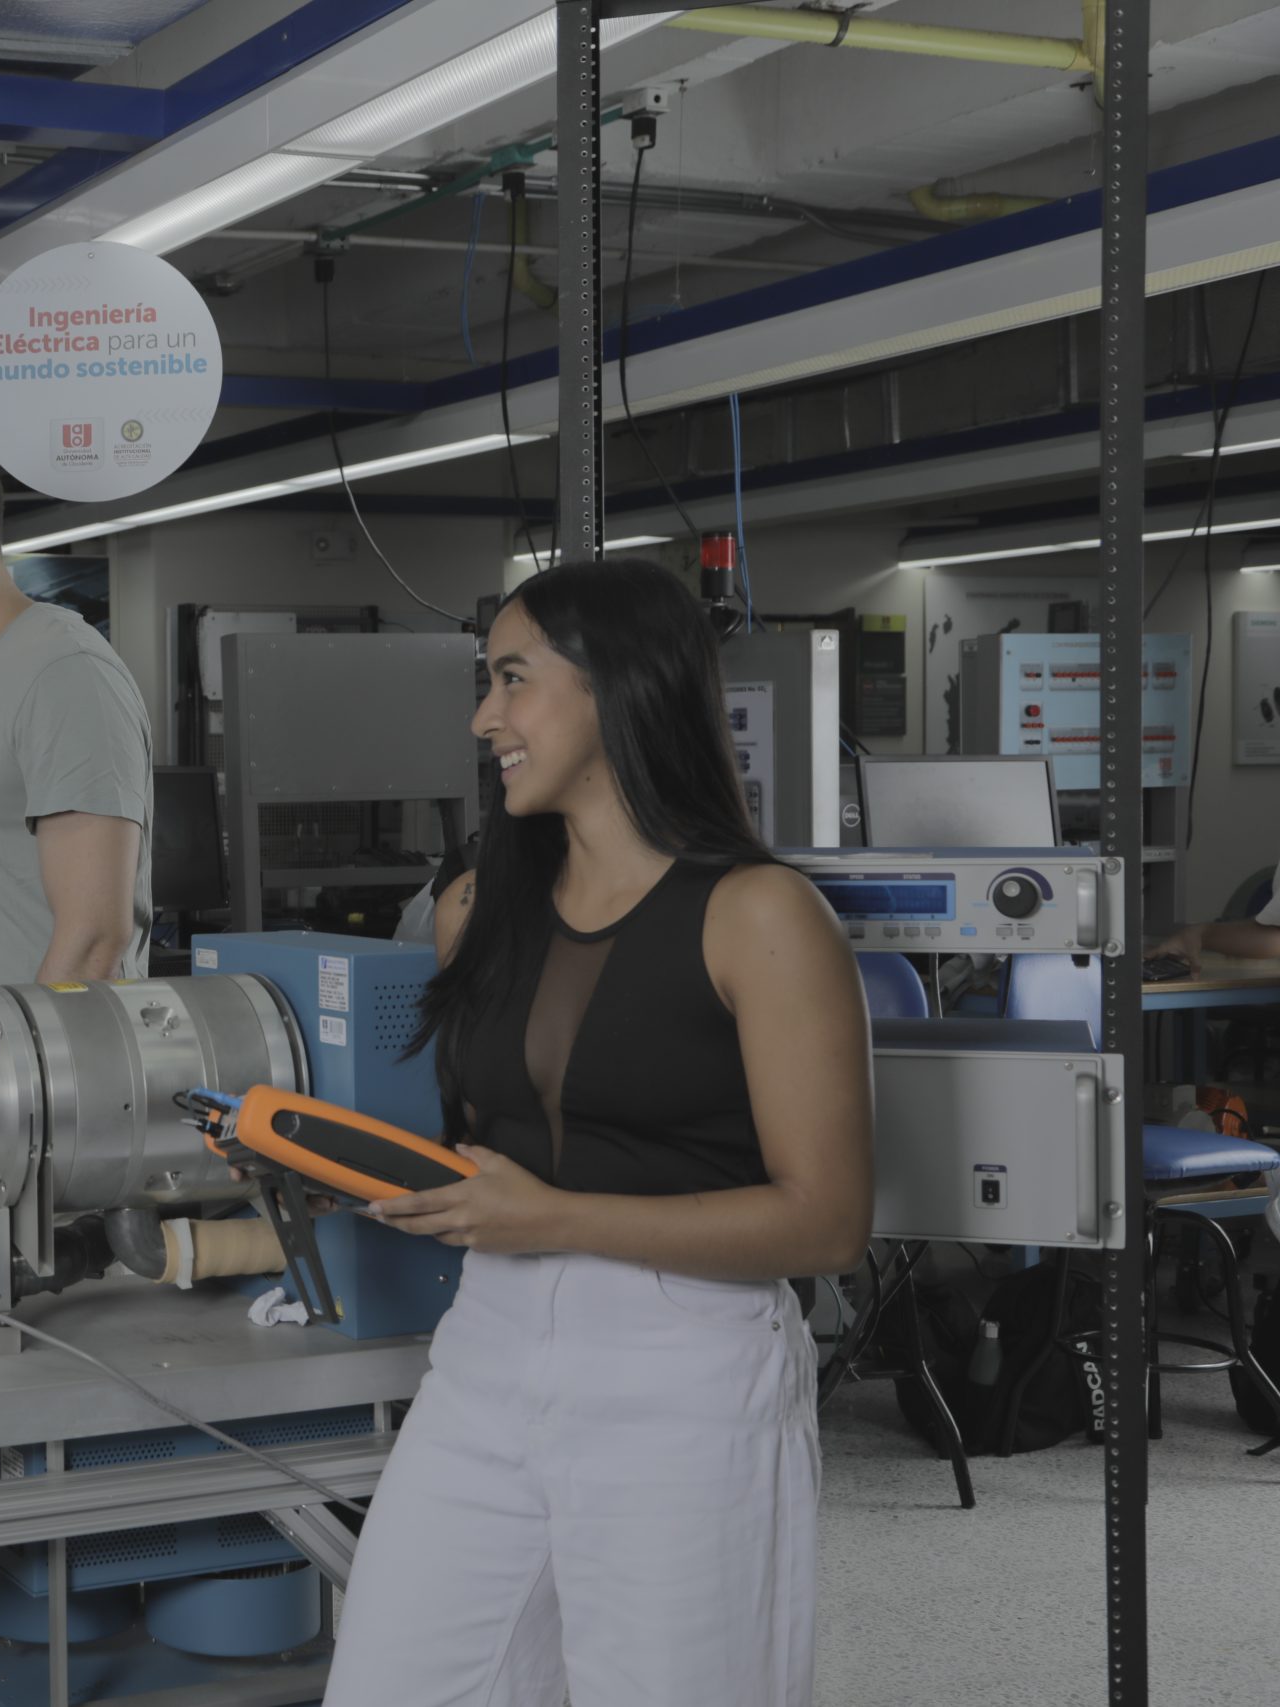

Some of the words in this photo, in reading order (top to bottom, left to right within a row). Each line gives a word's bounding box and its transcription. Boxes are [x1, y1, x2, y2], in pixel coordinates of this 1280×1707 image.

[28, 303, 157, 332] Ingeniería
[108, 333, 158, 355] para
[167, 331, 196, 349] un
[76, 353, 208, 378] sostenible
[56, 453, 99, 461] AUTÓNOMA
